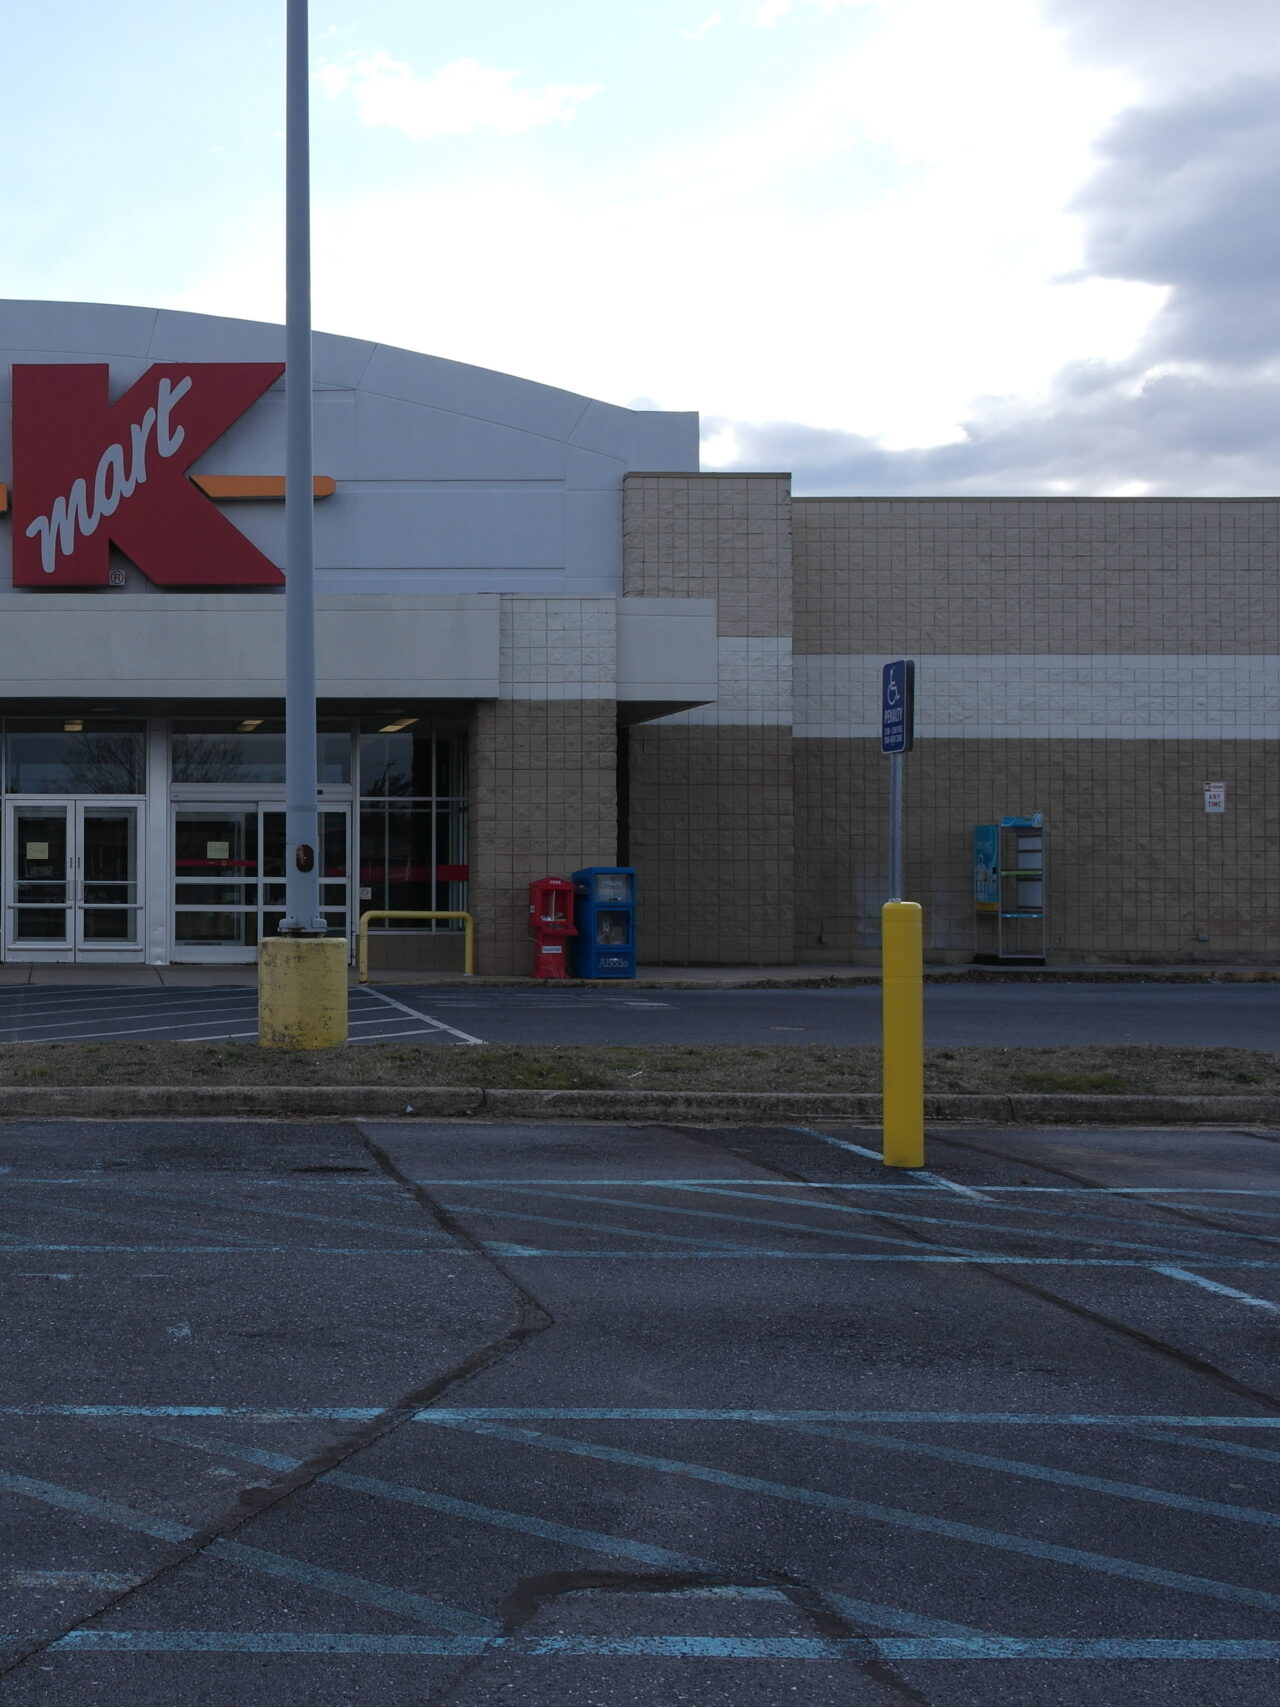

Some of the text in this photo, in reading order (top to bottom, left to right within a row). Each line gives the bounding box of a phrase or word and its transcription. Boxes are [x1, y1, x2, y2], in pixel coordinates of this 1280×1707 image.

[12, 362, 286, 588] K
[26, 375, 192, 574] mart
[1208, 793, 1221, 801] ANY
